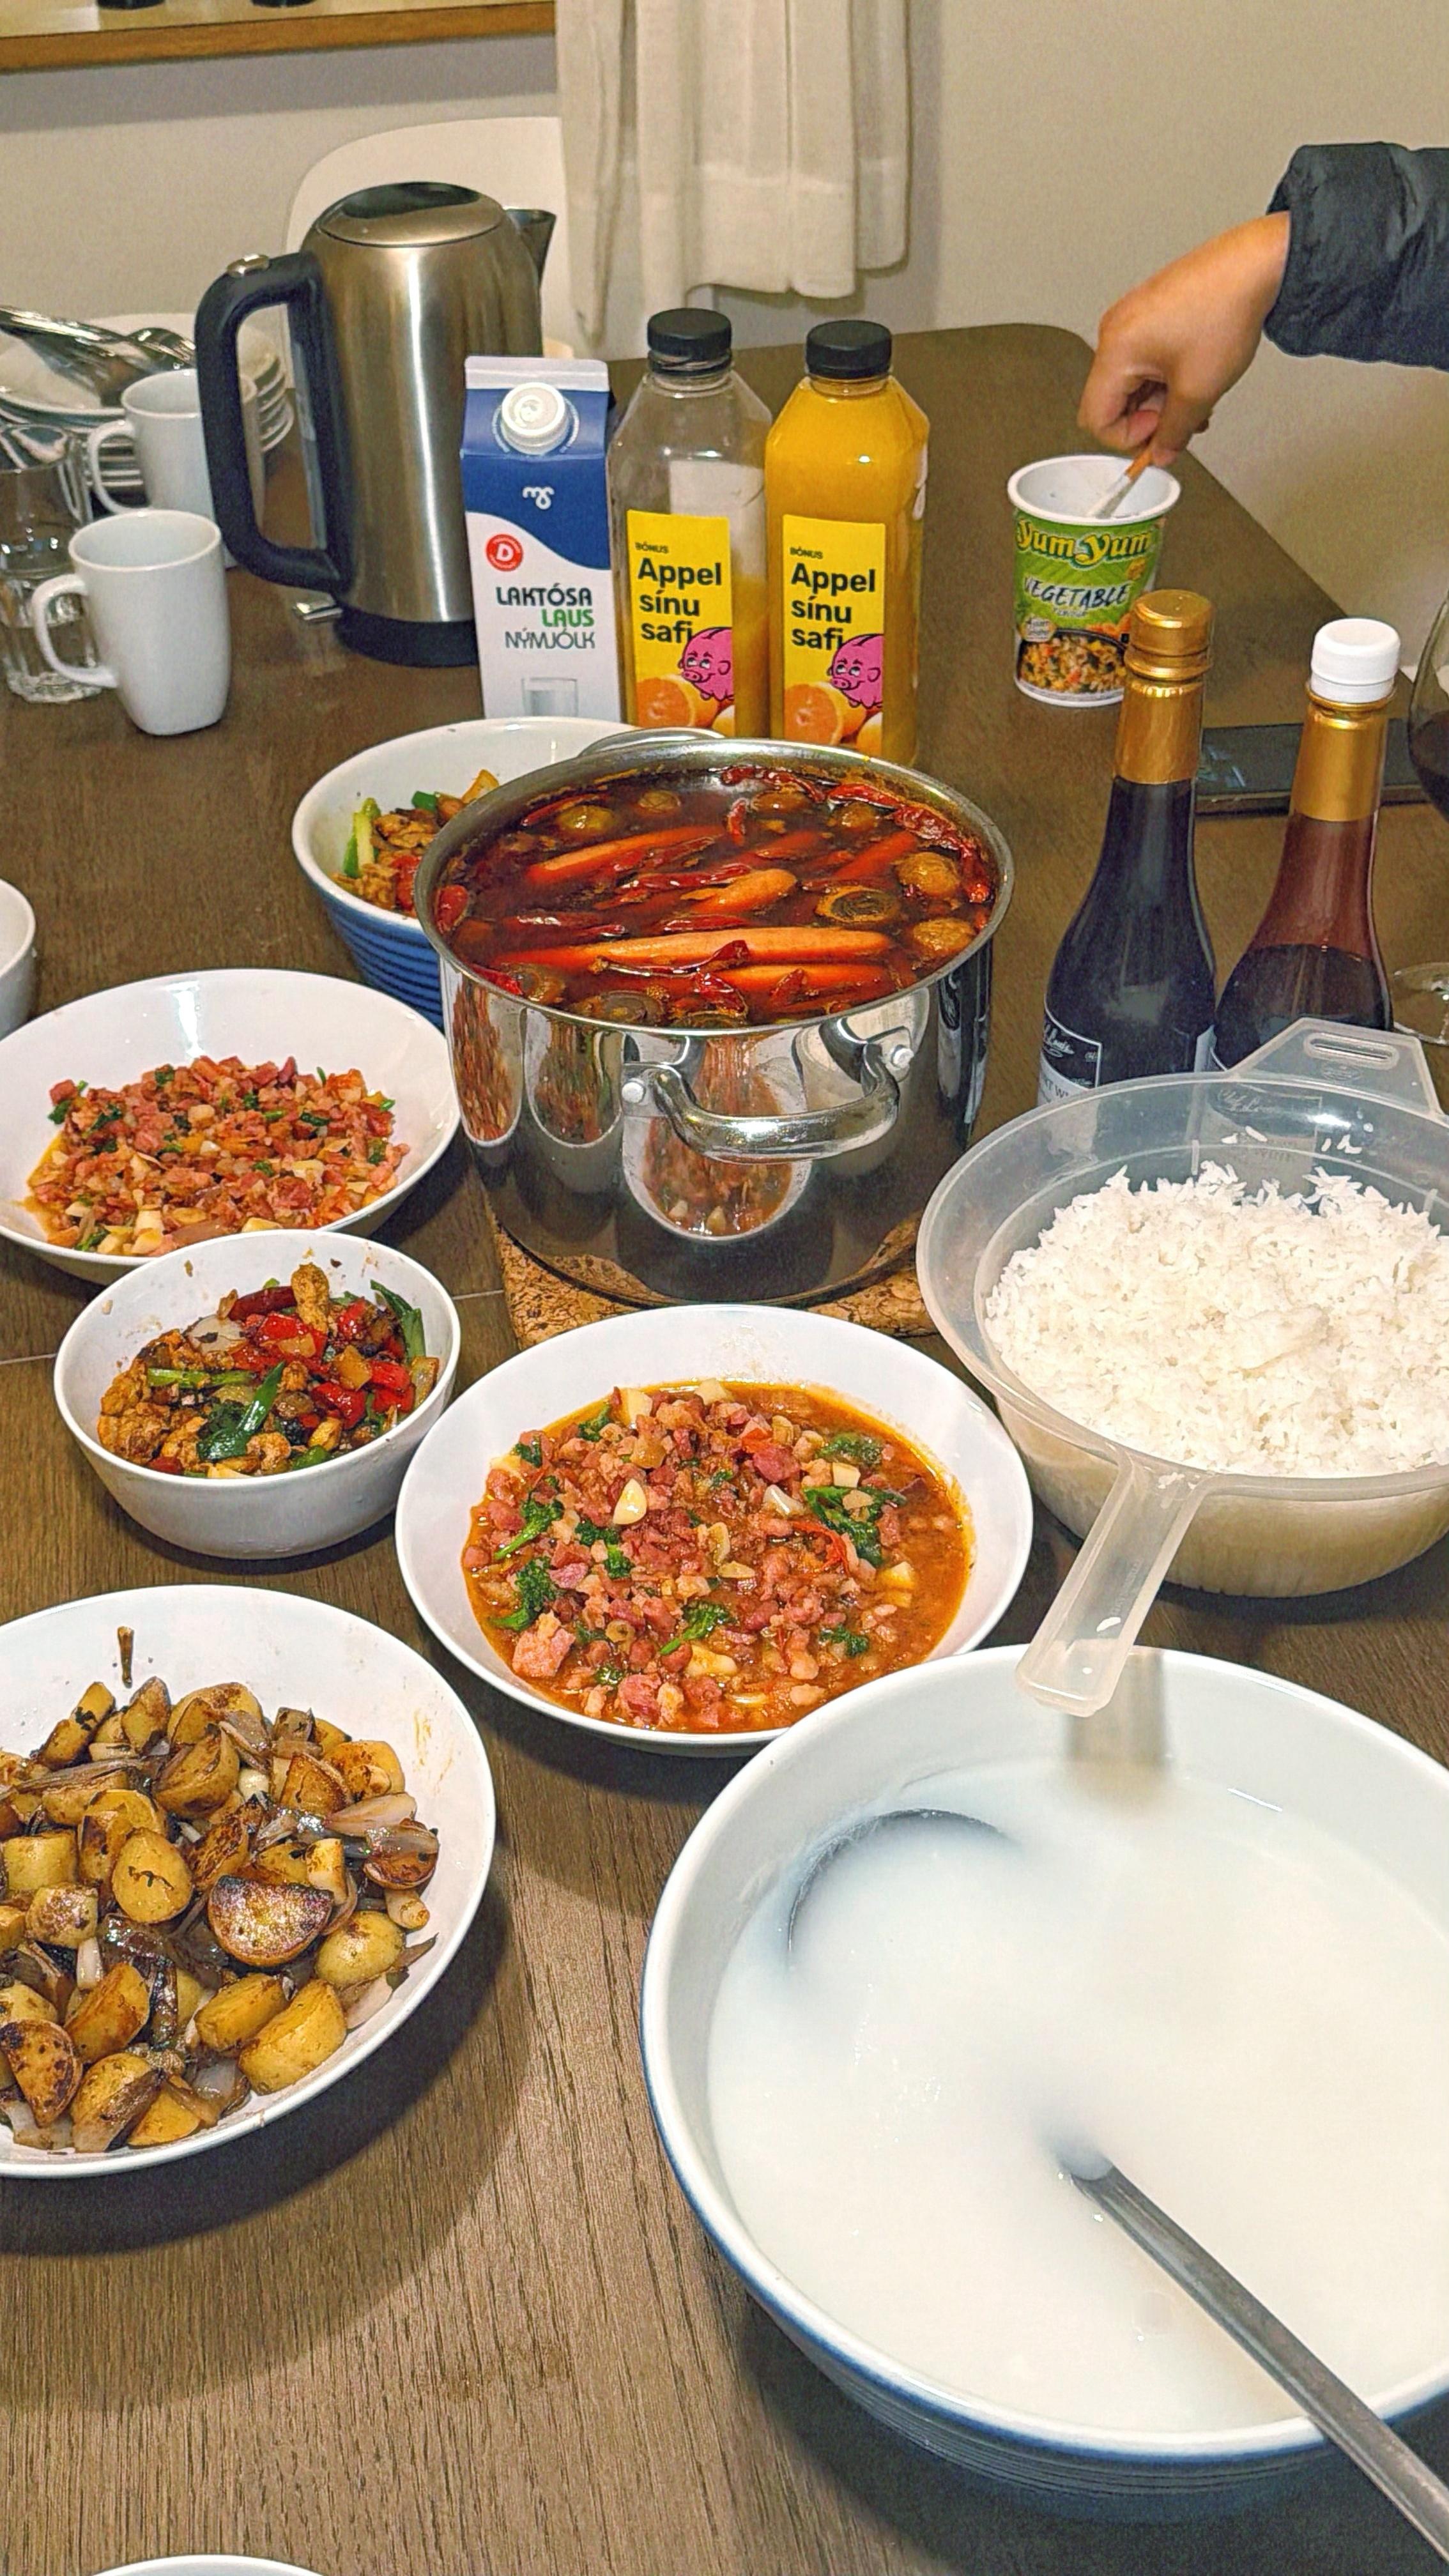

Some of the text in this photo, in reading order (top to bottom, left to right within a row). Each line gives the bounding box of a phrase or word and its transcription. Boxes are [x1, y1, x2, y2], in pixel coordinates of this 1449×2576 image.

[496, 543, 514, 562] D
[1016, 518, 1152, 566] Yum Yum
[638, 557, 722, 590] Appel
[791, 562, 876, 597] Appel
[495, 582, 593, 606] LAKTÓSA
[639, 589, 700, 617] sínu
[1025, 576, 1130, 610] VEGETABLE
[541, 609, 595, 628] LAUS
[791, 595, 852, 624] sínu
[504, 627, 595, 650] NÝMJÓLK
[641, 620, 693, 644] safi
[792, 627, 844, 651] safi
